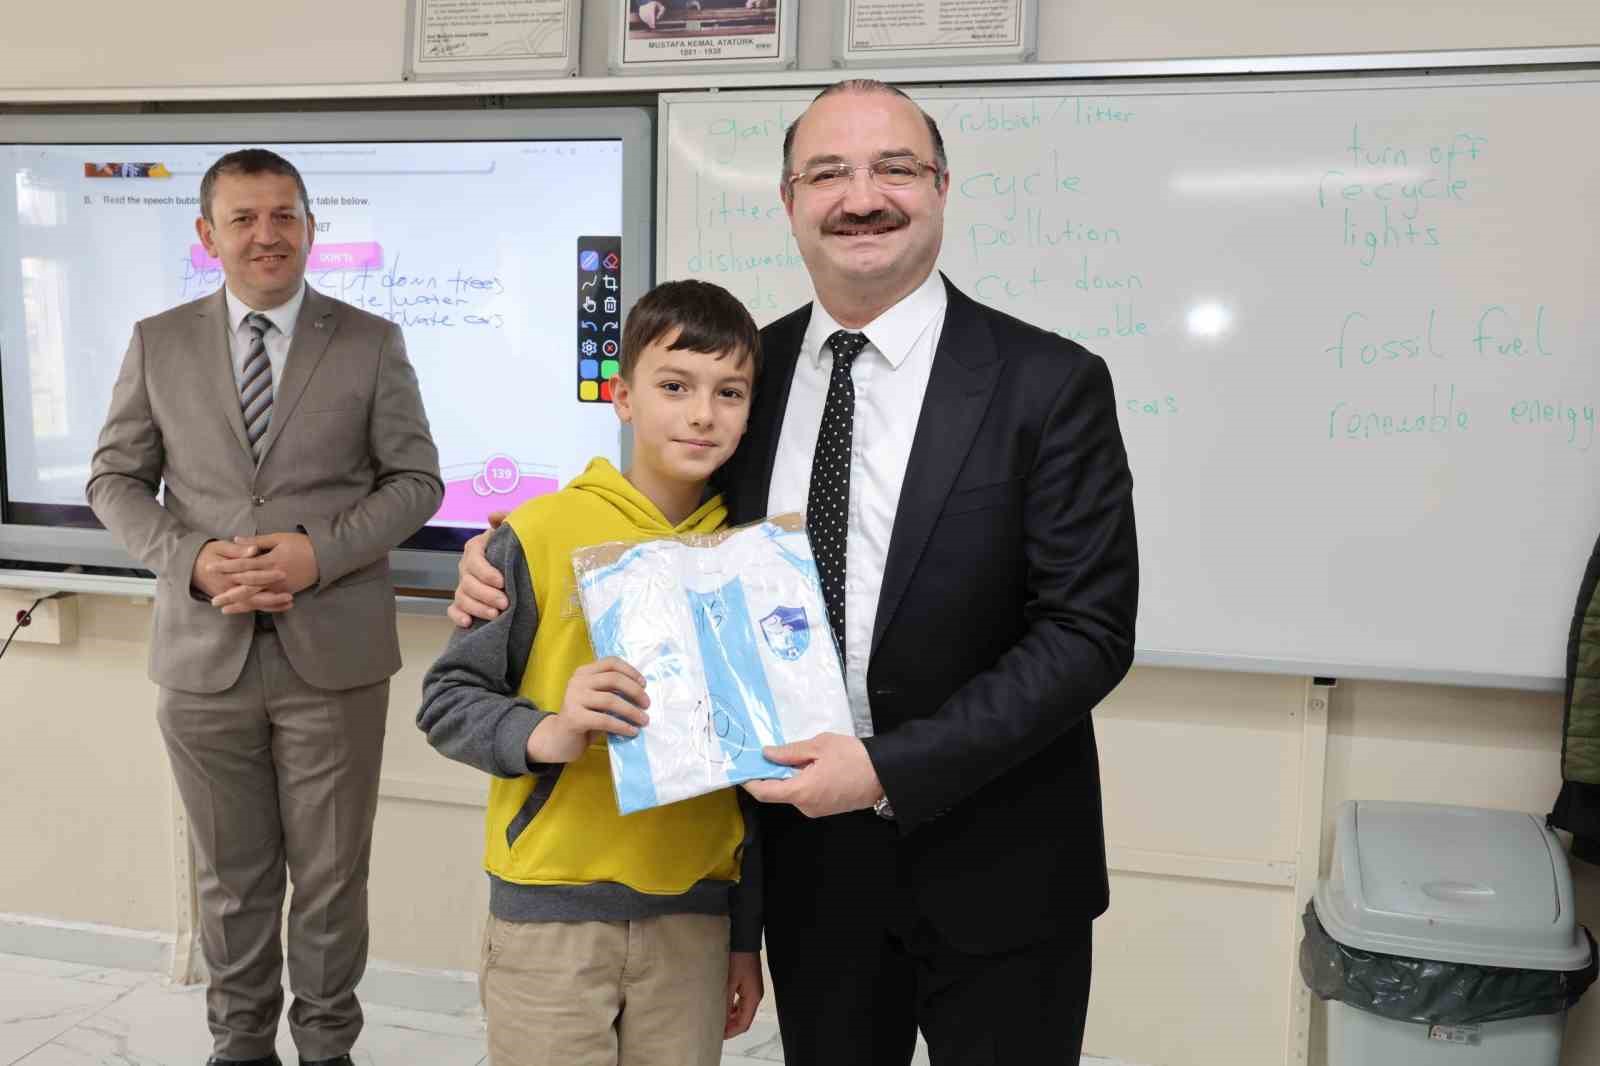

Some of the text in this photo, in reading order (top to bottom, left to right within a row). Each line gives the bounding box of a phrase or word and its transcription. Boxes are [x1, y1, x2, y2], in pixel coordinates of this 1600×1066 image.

[1347, 119, 1407, 167] turn
[103, 195, 125, 205] Read
[128, 195, 140, 205] the
[144, 195, 173, 208] speech
[317, 196, 339, 206] table
[1319, 169, 1468, 219] recycle
[968, 207, 1120, 259] pollution
[1344, 206, 1441, 266] lights
[1075, 255, 1142, 291] down
[1324, 304, 1552, 368] fossil fuel
[1328, 383, 1469, 439] renewable
[492, 468, 512, 480] 139
